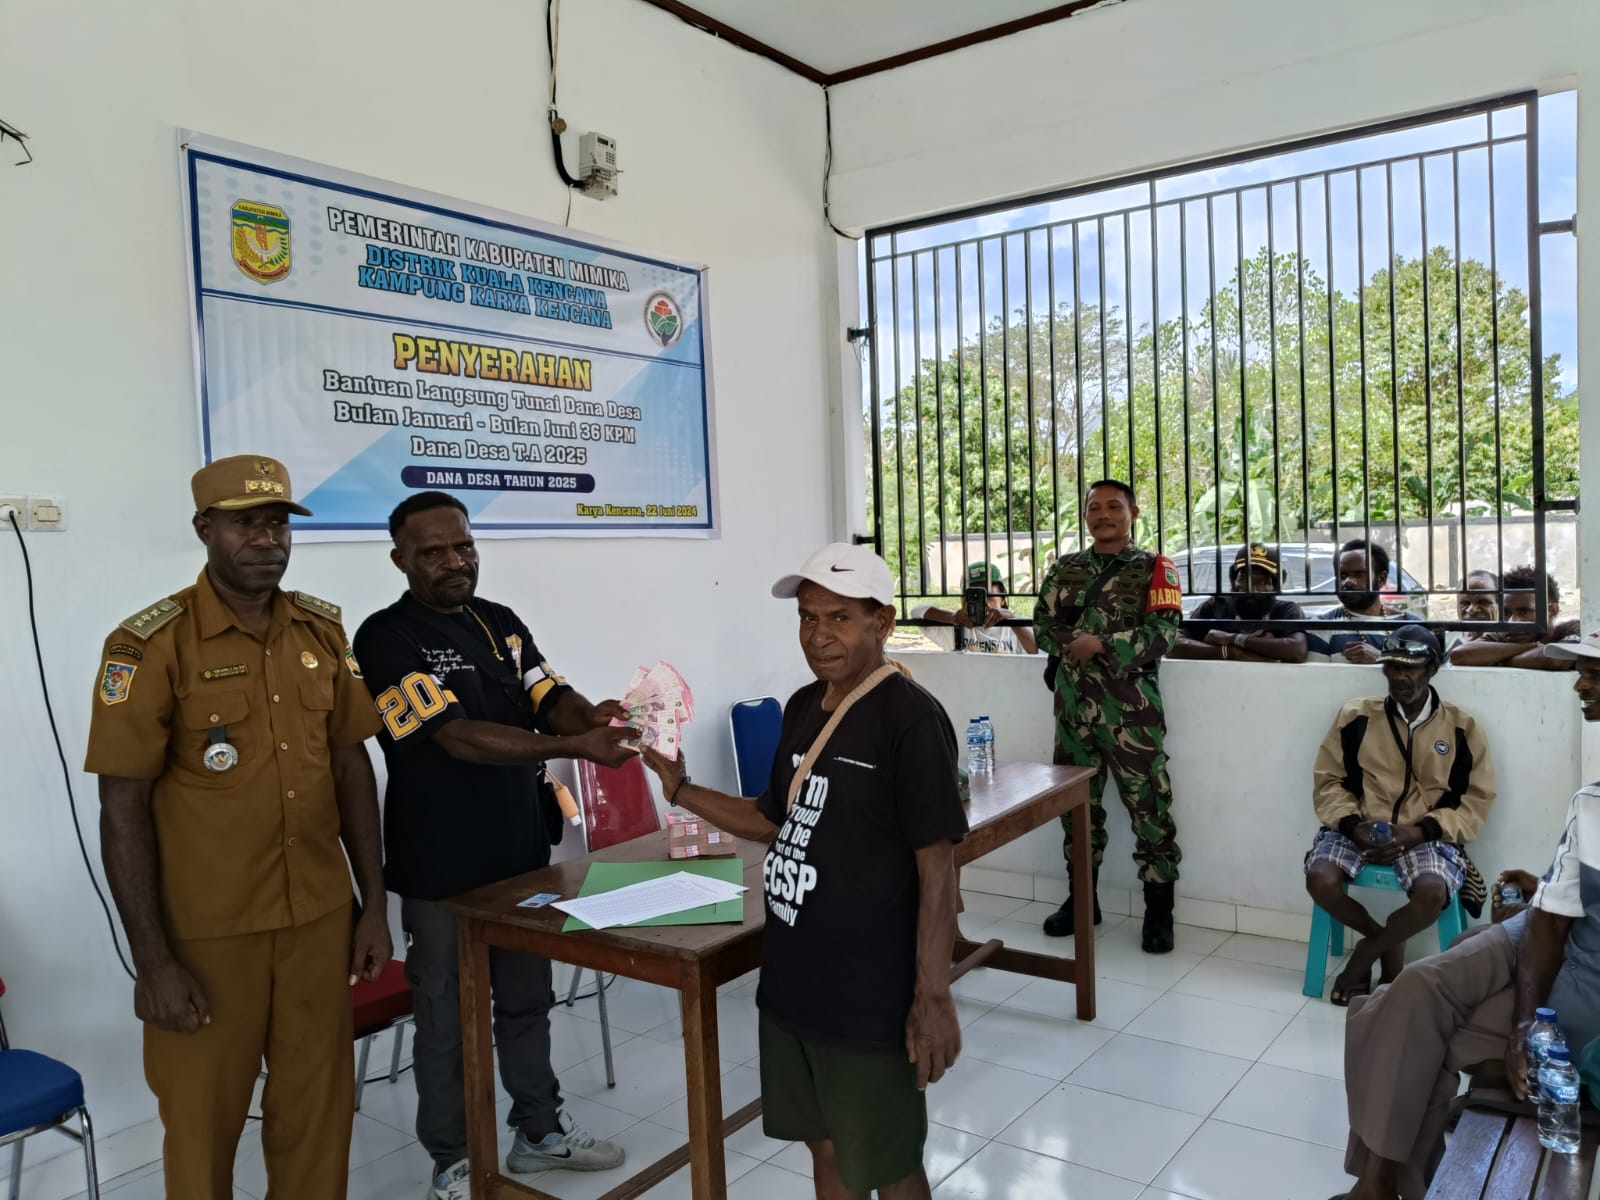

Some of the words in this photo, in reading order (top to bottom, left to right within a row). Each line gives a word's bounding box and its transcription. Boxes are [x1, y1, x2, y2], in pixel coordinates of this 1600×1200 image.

[327, 206, 461, 257] PEMERINTAH
[465, 237, 566, 279] KABUPATEN
[568, 259, 630, 292] MIMIKA
[358, 265, 465, 303] KAMPUNG
[470, 285, 531, 315] KARYA
[534, 297, 613, 329] KENCANA
[366, 244, 457, 280] DISTRIK
[460, 263, 524, 293] KUALA
[527, 276, 608, 309] KENCANA
[392, 333, 592, 391] PENYERAHAN
[323, 369, 413, 398] Bantuan
[416, 379, 508, 411] Langsung
[512, 390, 561, 413] Tunai
[564, 396, 604, 417] Dana
[607, 401, 642, 421] Desa
[334, 401, 399, 425] Bulan
[402, 406, 473, 431] Januari
[476, 420, 486, 428] -
[489, 415, 541, 437] Bulan
[543, 419, 577, 439] Juni
[580, 423, 602, 441] 36
[604, 424, 636, 444] KPM
[411, 435, 461, 458] Dana
[465, 439, 510, 461] Desa
[512, 442, 542, 462] T.A
[545, 445, 588, 465] 2025
[426, 471, 463, 485] DANA
[467, 473, 500, 486] DESA
[504, 475, 545, 488] TAHUN
[548, 477, 577, 489] 2025
[576, 503, 604, 518] Karya
[604, 504, 645, 518] Kencana,
[646, 504, 658, 516] 22
[659, 504, 675, 516] Juni
[676, 504, 697, 517] 2024
[375, 671, 448, 741] 20
[790, 804, 823, 827] roud
[791, 823, 811, 848] be
[784, 845, 792, 857] of
[792, 847, 806, 861] the
[763, 851, 817, 905] ECSP
